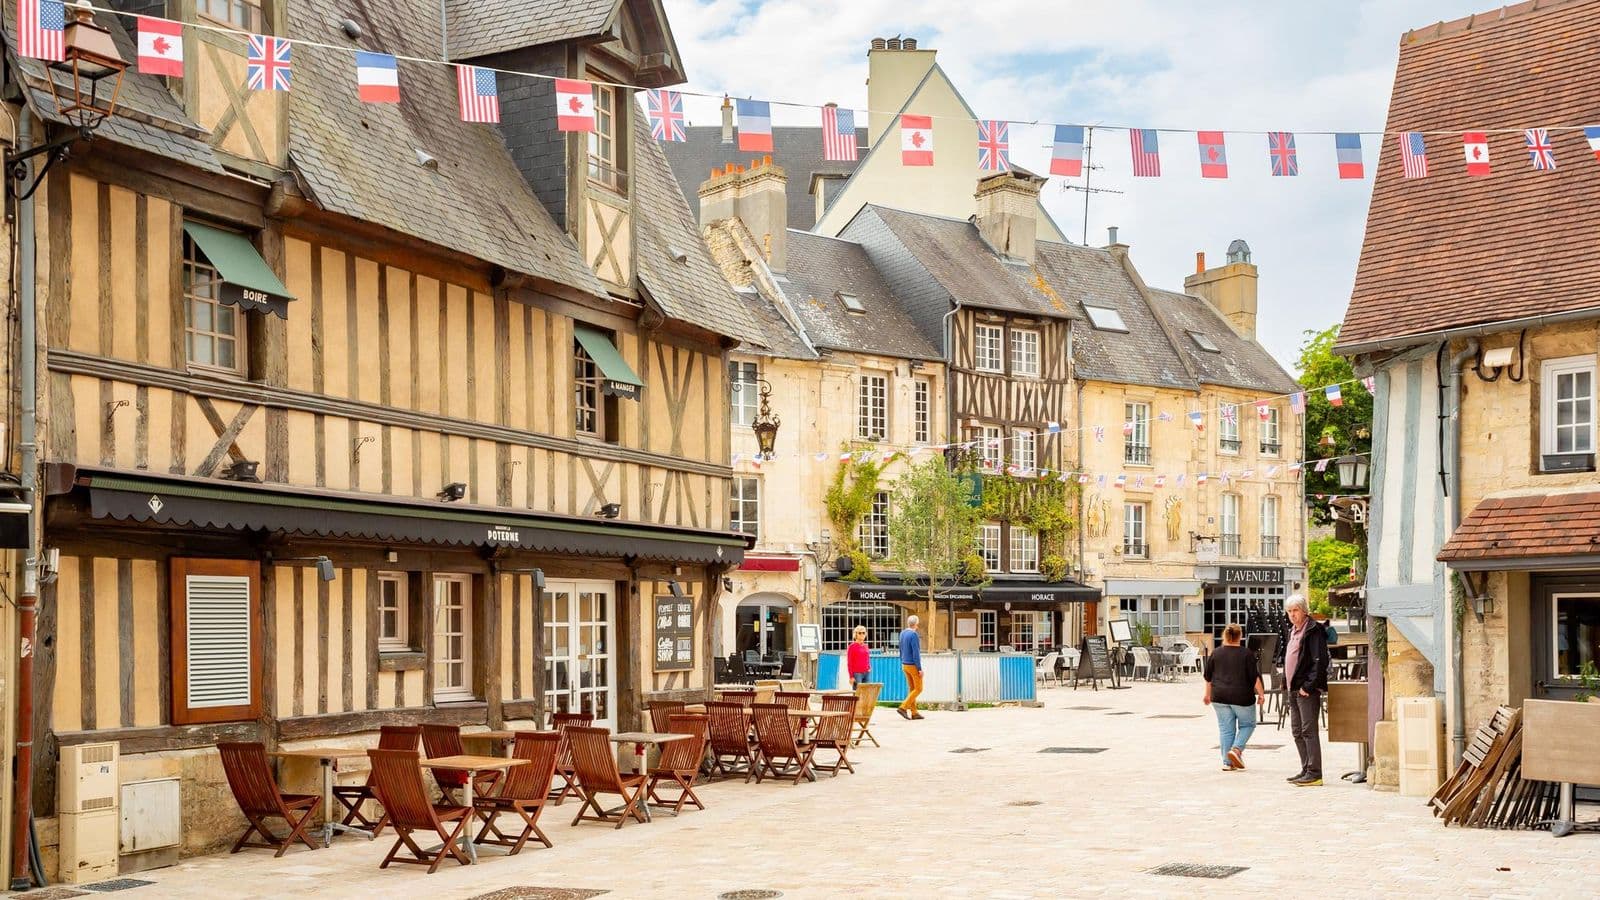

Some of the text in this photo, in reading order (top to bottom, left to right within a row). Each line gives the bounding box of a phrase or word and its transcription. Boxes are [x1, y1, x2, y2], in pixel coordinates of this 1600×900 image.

[243, 289, 268, 304] BOIRE
[615, 382, 635, 393] MANGER
[487, 529, 519, 542] POTERNE
[1226, 570, 1281, 582] L'AVENUE 21
[860, 591, 887, 600] HORACE
[1031, 593, 1055, 601] HORACE
